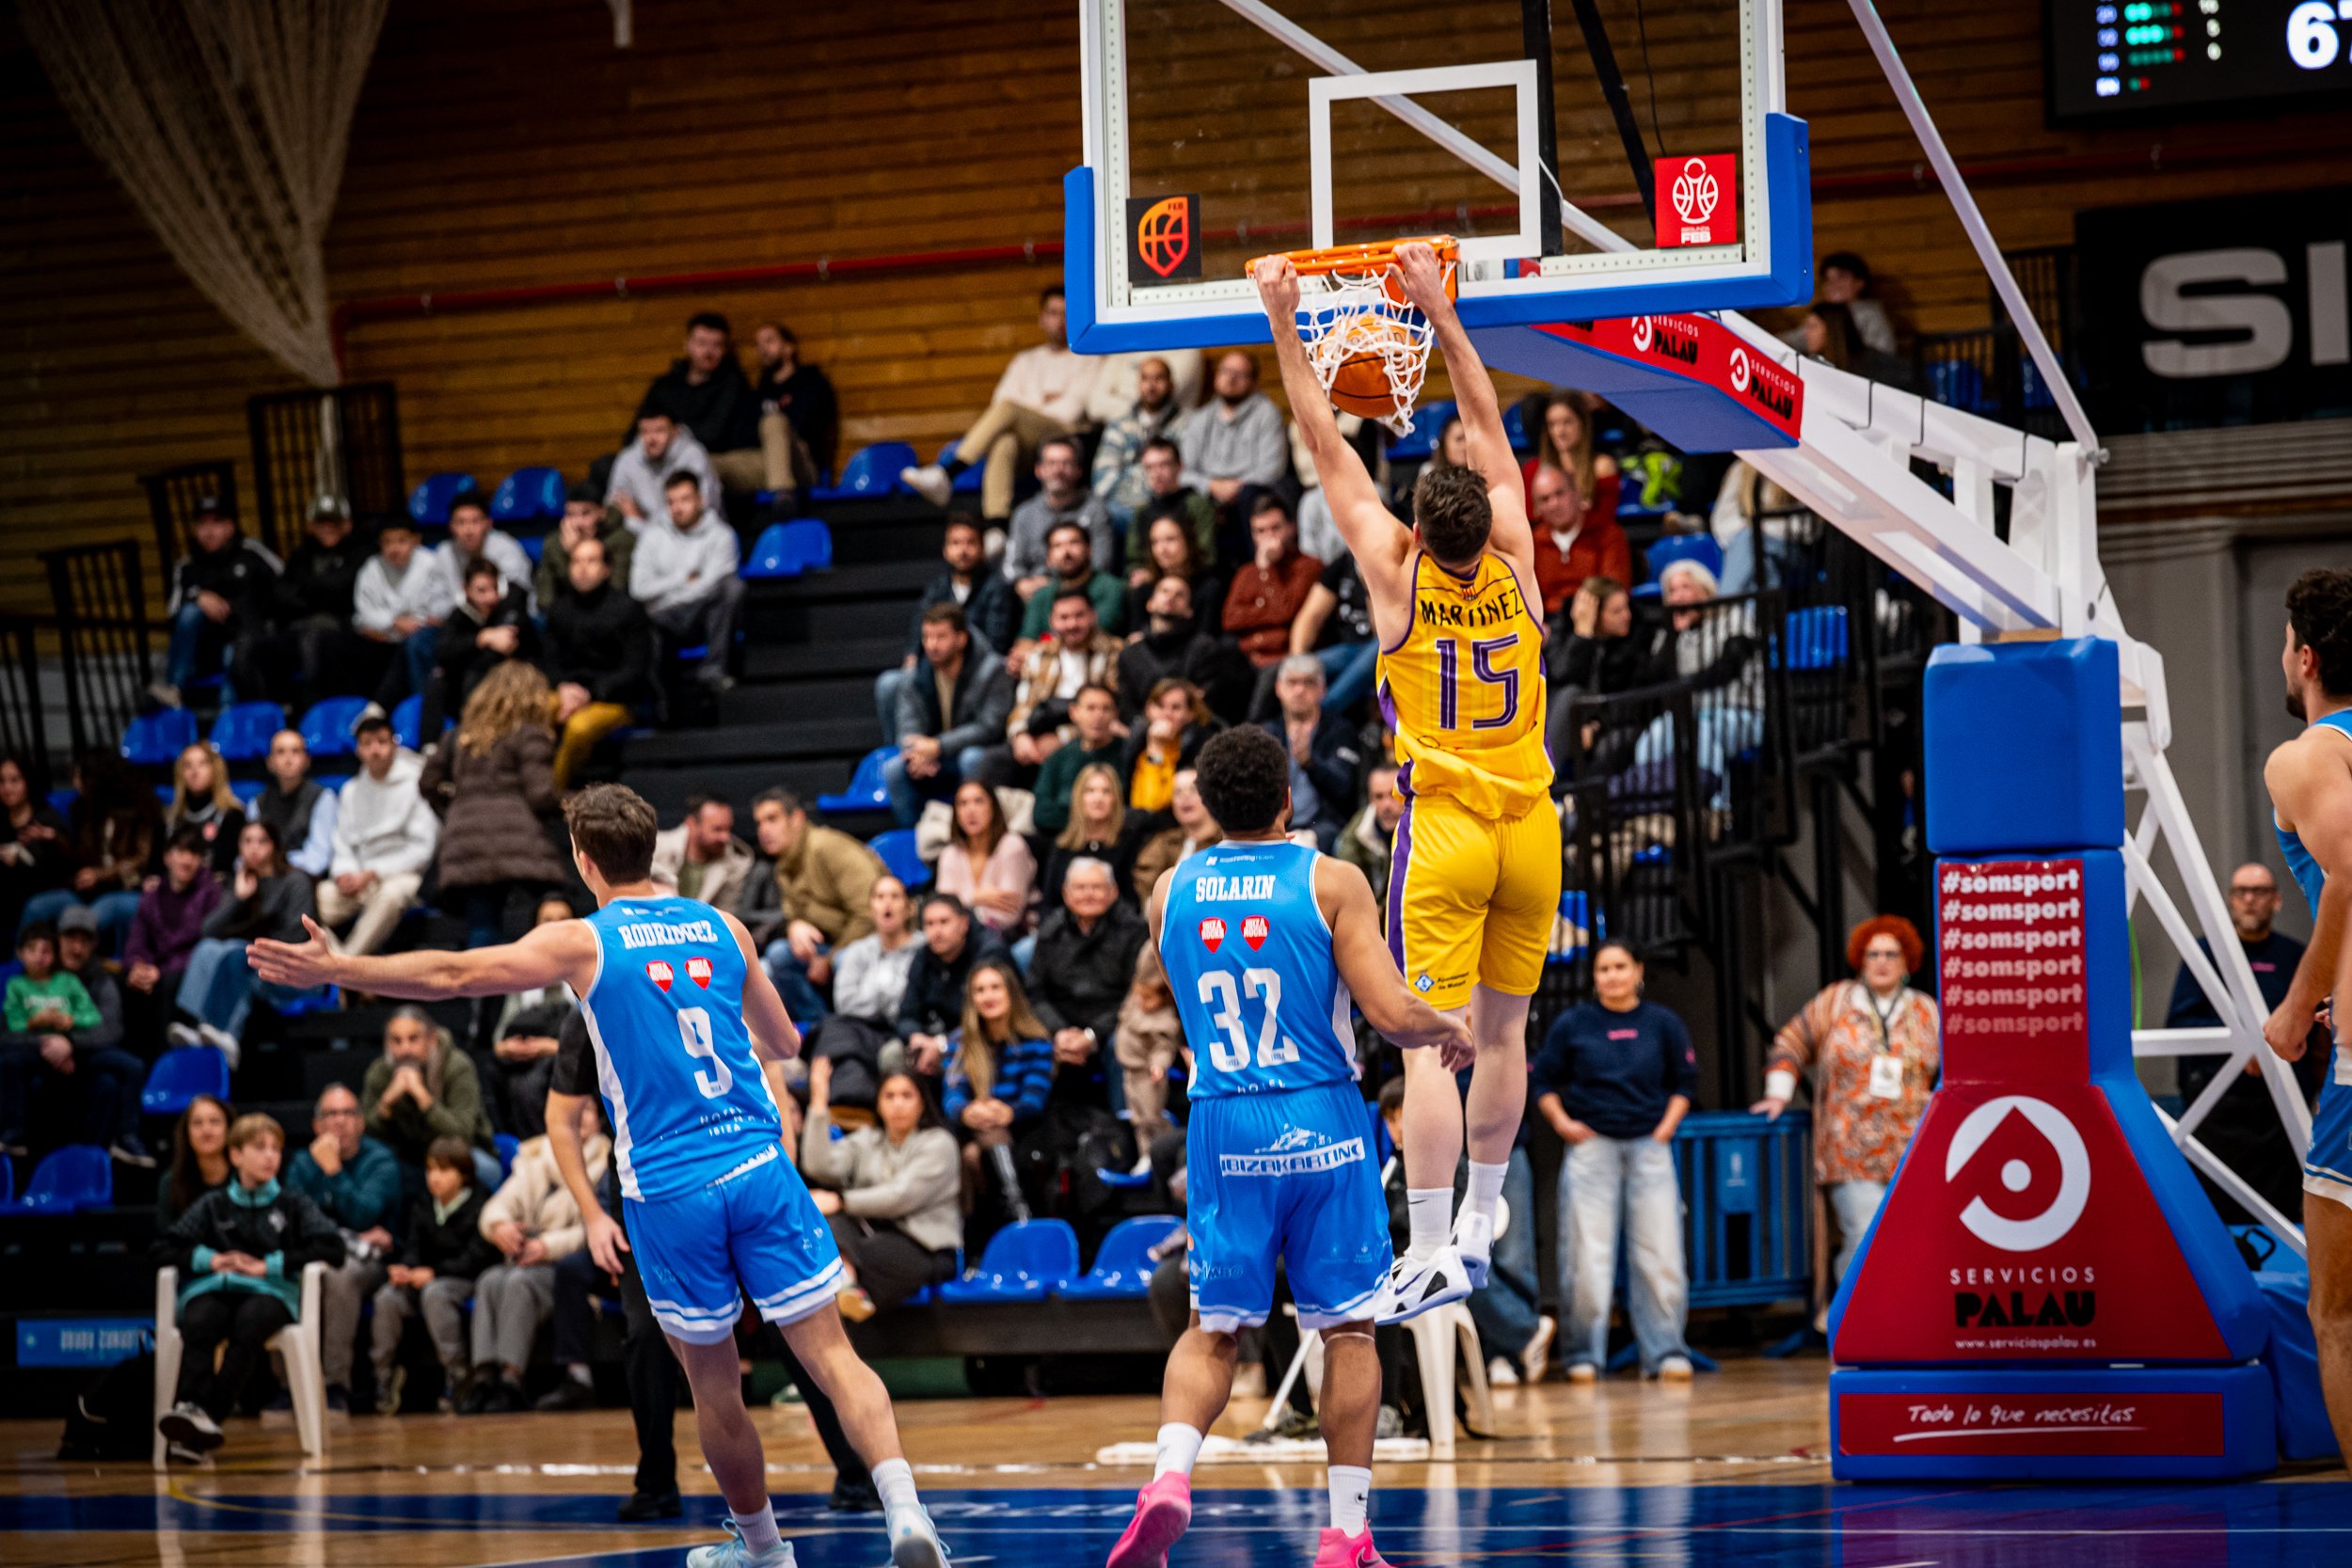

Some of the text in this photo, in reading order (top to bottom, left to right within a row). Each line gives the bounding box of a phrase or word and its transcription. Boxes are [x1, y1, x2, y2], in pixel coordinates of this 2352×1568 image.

[2286, 0, 2352, 70] 6
[1680, 231, 1711, 245] FEB
[1653, 315, 1699, 338] SERVICIOS
[1654, 329, 1698, 365] PALAU
[1751, 358, 1796, 396] SERVICIOS
[1751, 374, 1793, 420] PALAU
[1435, 631, 1519, 730] 15
[1196, 875, 1276, 903] SOLARIN
[1942, 868, 2080, 896] #somsport
[1943, 897, 2080, 926] #somsport
[1944, 926, 2081, 954] #somsport
[1944, 955, 2082, 982] #somsport
[1946, 983, 2083, 1009] #somsport
[1198, 967, 1300, 1072] 32
[1947, 1011, 2084, 1037] #somsport
[676, 1006, 734, 1100] 9
[1949, 1266, 2095, 1285] SERVICIOS
[1955, 1290, 2095, 1328] PALAU
[1955, 1334, 2097, 1351] www.serviciospalau.es
[1908, 1403, 2135, 1425] Todo lo que necesitas
